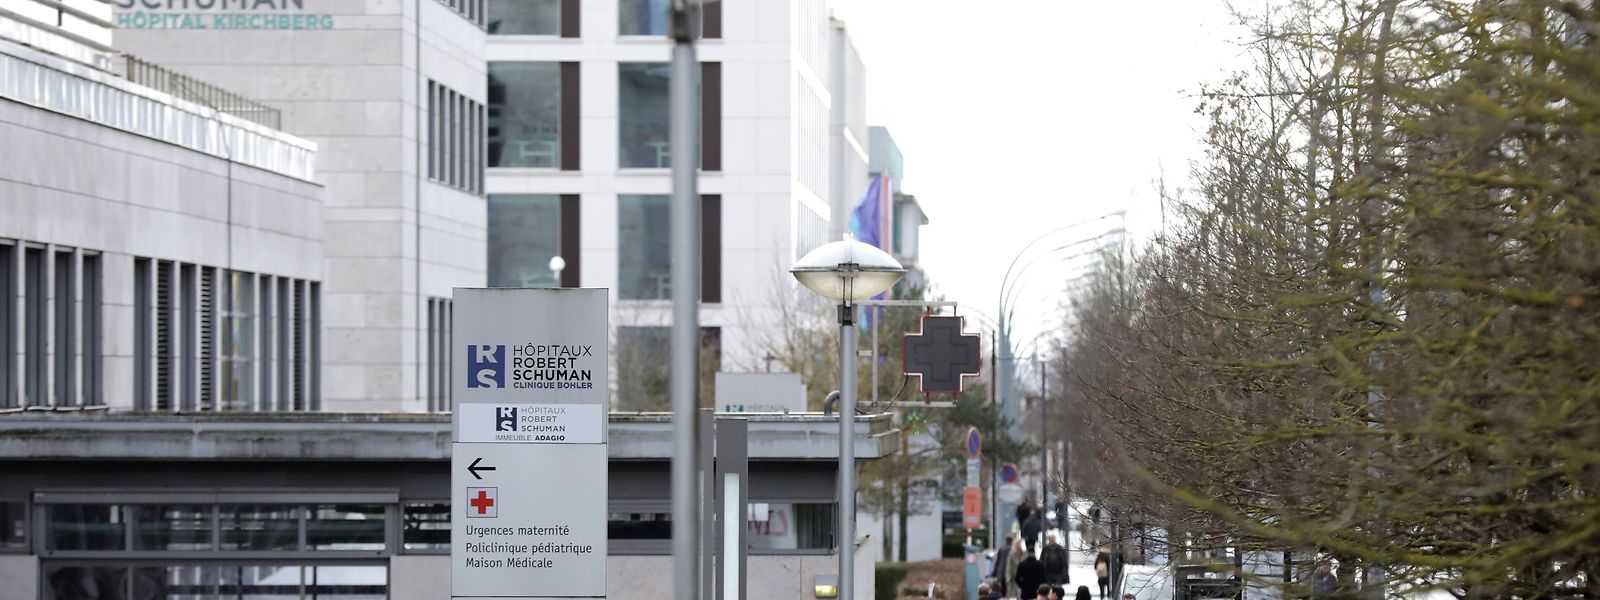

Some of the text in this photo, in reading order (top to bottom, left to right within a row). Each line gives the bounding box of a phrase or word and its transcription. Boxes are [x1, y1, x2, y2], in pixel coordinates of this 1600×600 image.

[117, 9, 333, 30] HÔPITAL KIRCHBERG
[513, 342, 592, 356] HÔPITAUX
[513, 358, 577, 369] ROBERT
[513, 369, 592, 381] SCHUMAN
[513, 381, 593, 389] CLINIQUE BOHLER
[521, 406, 566, 414] HÔPITAUX
[521, 415, 557, 423] ROBERT
[466, 525, 570, 538] Urgences maternité
[466, 542, 592, 556] Policlinique pédiatrique
[466, 557, 553, 568] Maison Médicale
